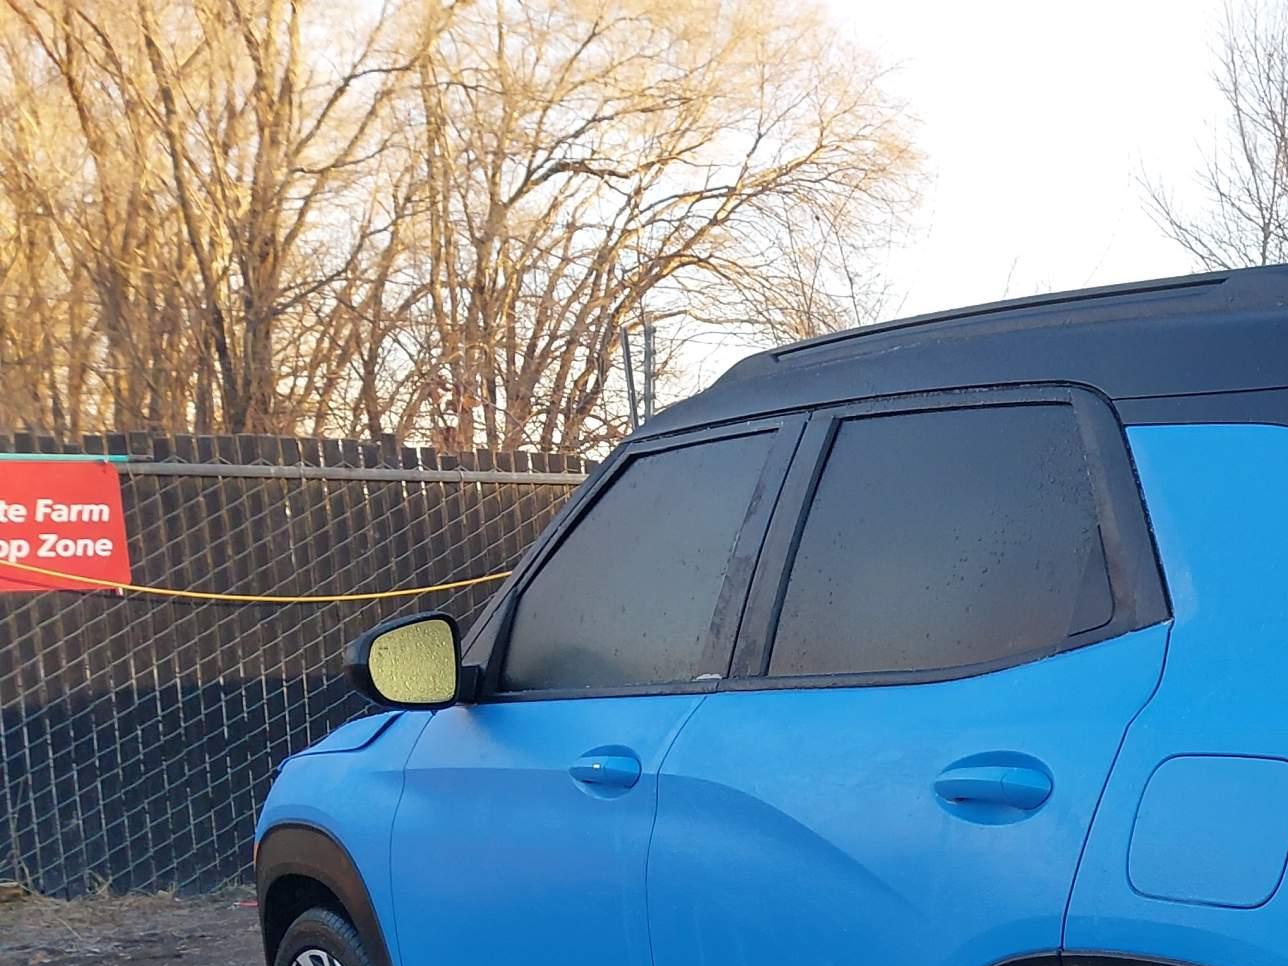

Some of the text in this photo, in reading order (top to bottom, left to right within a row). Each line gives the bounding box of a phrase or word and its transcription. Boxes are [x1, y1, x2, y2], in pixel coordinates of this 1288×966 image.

[0, 499, 110, 523] te Farm
[36, 533, 113, 557] Zone
